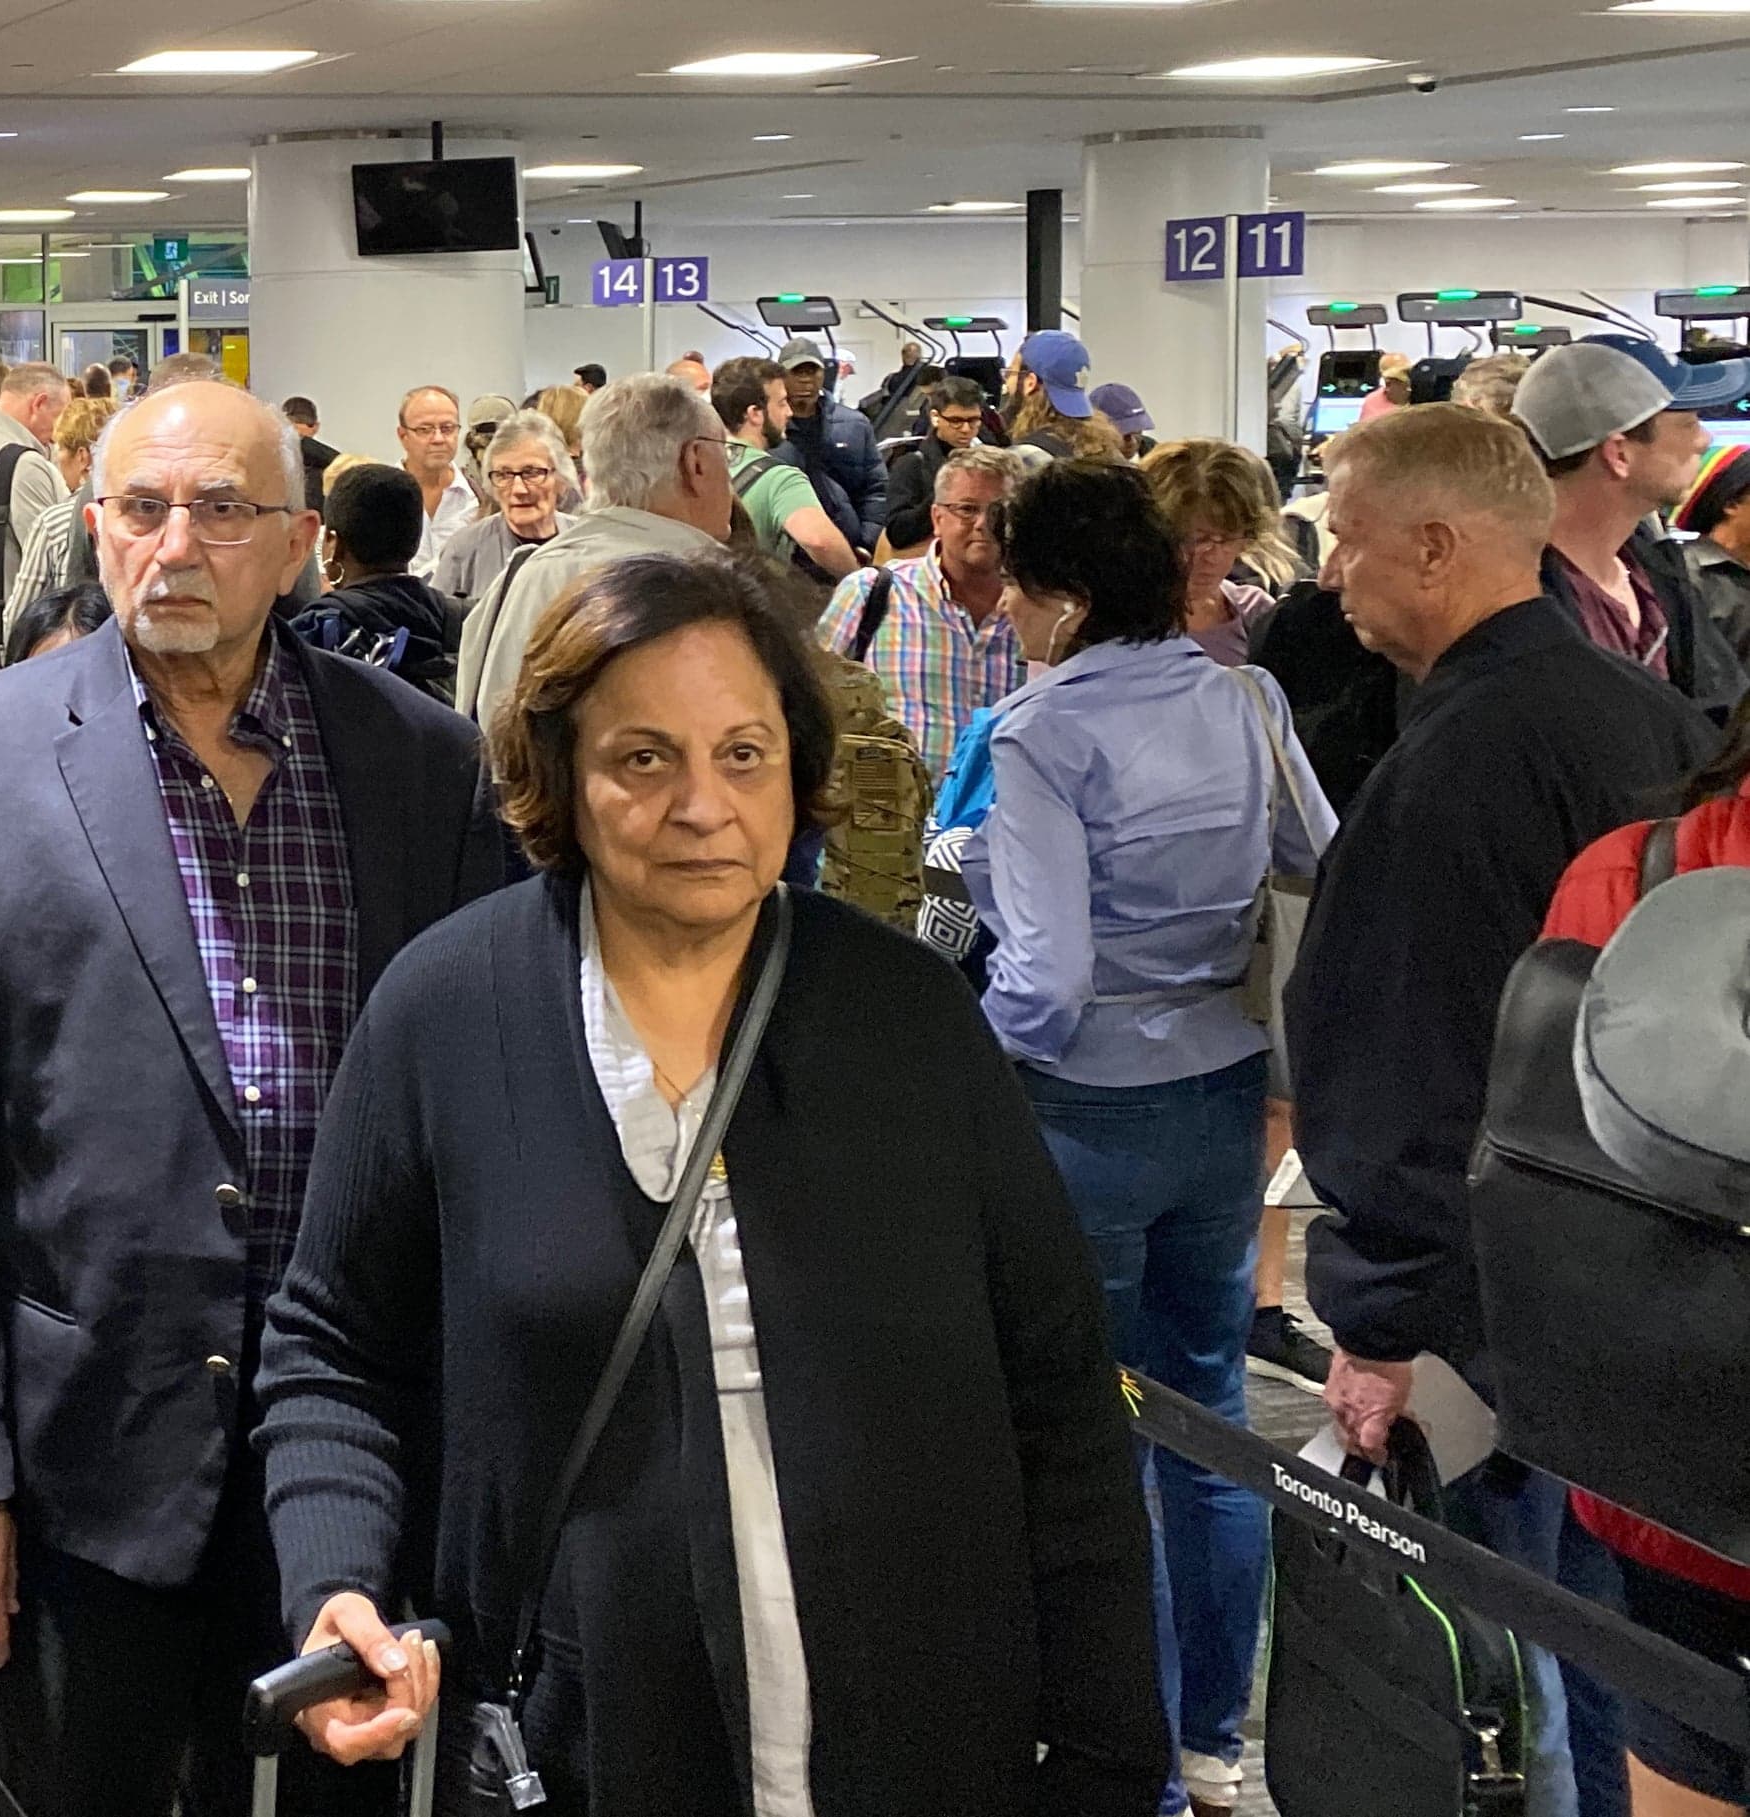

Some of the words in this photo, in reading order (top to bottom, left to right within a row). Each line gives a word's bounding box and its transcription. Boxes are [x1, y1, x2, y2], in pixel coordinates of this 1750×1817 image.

[1174, 226, 1217, 272] 12
[1248, 221, 1292, 268] 11
[194, 291, 218, 304] Exit
[598, 265, 638, 298] 14
[661, 262, 700, 296] 13
[1271, 1463, 1343, 1518] Toronto
[1346, 1502, 1427, 1564] Pearson
